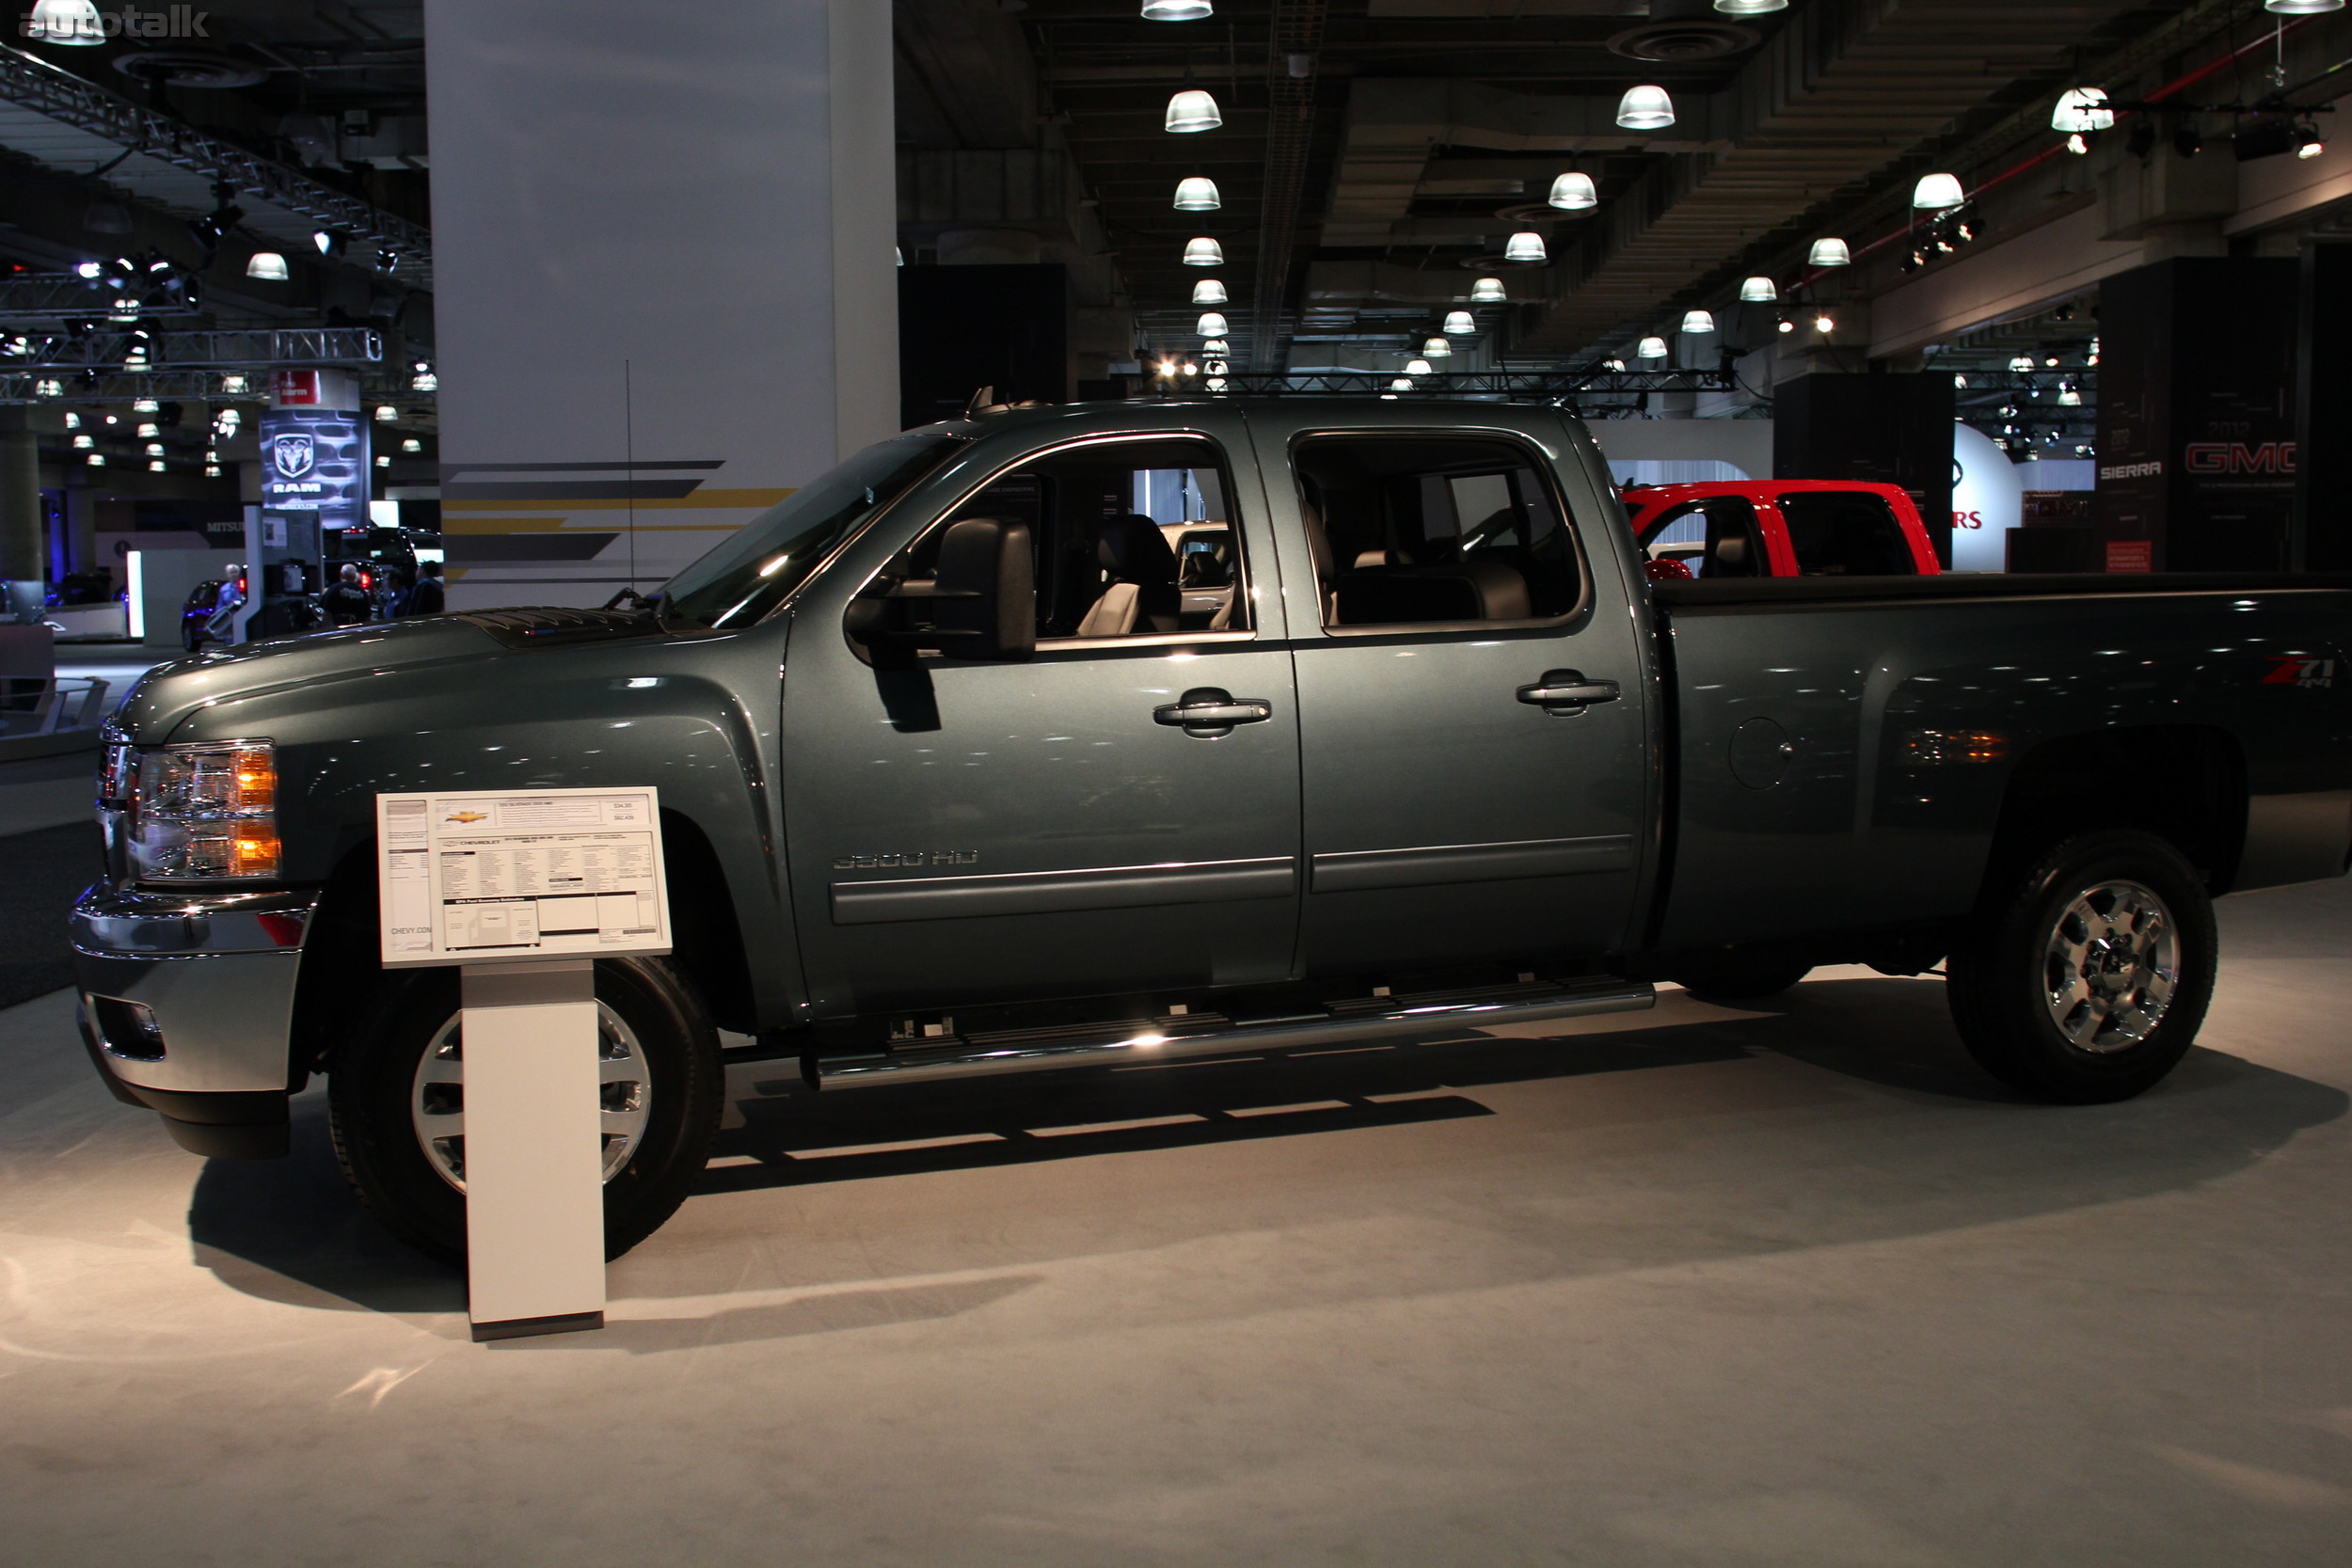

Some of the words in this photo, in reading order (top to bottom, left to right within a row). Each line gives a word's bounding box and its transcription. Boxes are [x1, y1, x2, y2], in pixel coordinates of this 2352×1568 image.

[2100, 461, 2163, 481] SIERRA
[272, 483, 322, 494] RAM
[2261, 656, 2336, 685] Z71
[832, 852, 924, 870] 3500
[931, 849, 978, 866] HD
